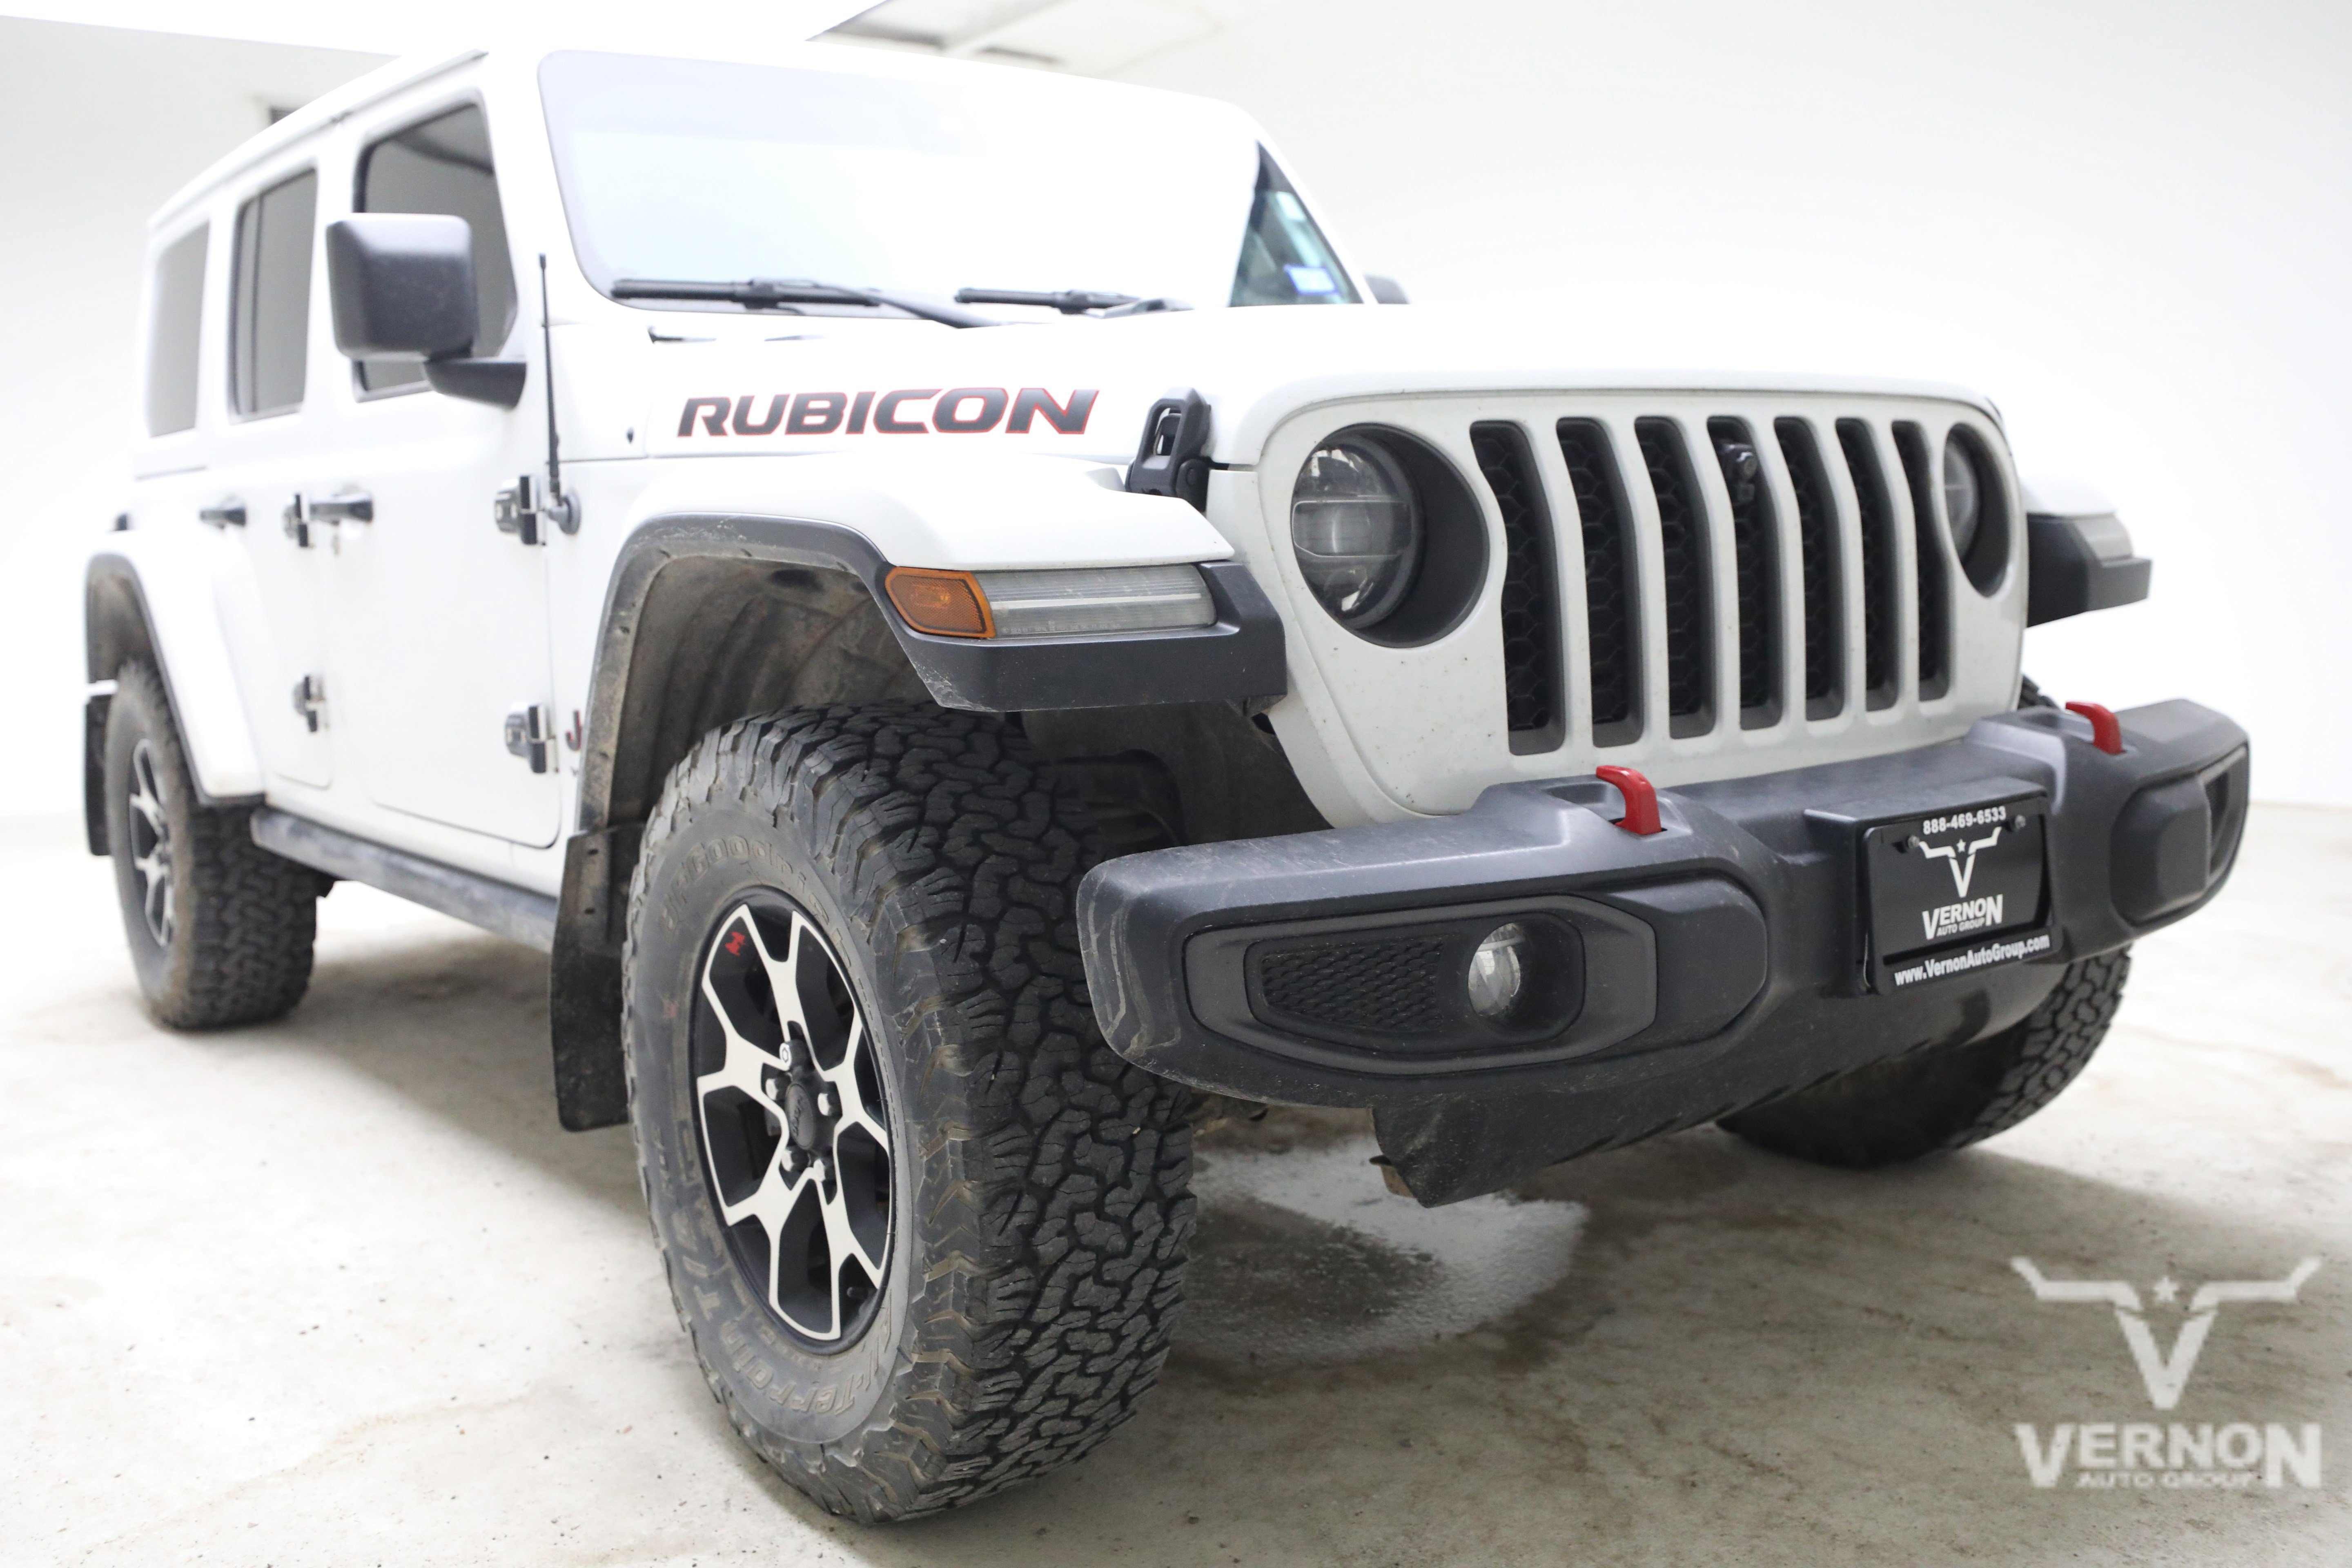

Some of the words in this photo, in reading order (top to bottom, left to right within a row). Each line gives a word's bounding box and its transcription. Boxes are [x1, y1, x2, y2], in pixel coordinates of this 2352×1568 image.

[676, 387, 1100, 437] RUBICON
[1923, 805, 2007, 835] 888-469-6533
[1922, 893, 2003, 940] VERNON
[1936, 923, 1958, 937] AUTO
[1958, 917, 1985, 932] GROUP
[1894, 934, 2050, 986] www.VernonAutoGroup.com
